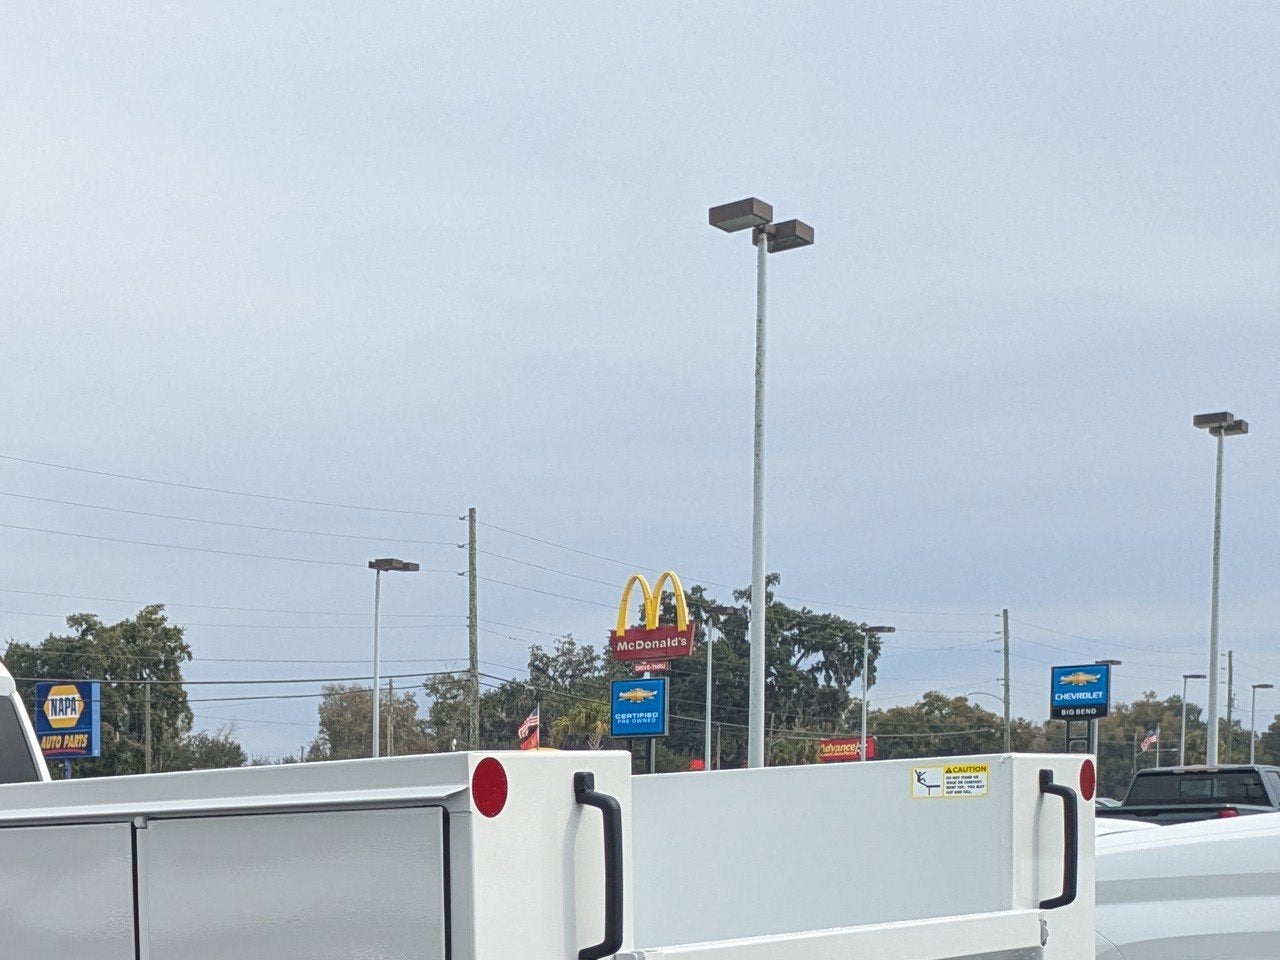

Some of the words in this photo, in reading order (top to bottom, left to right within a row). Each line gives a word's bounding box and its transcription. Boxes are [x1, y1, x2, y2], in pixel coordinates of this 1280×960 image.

[616, 637, 687, 652] McDonald's
[634, 663, 666, 671] DRIVE-THRU
[1055, 691, 1104, 701] CHEVROLET
[50, 697, 77, 716] NAPA
[615, 711, 659, 719] CERTIFIED
[41, 735, 62, 749] AUTO
[63, 734, 89, 748] PARTS
